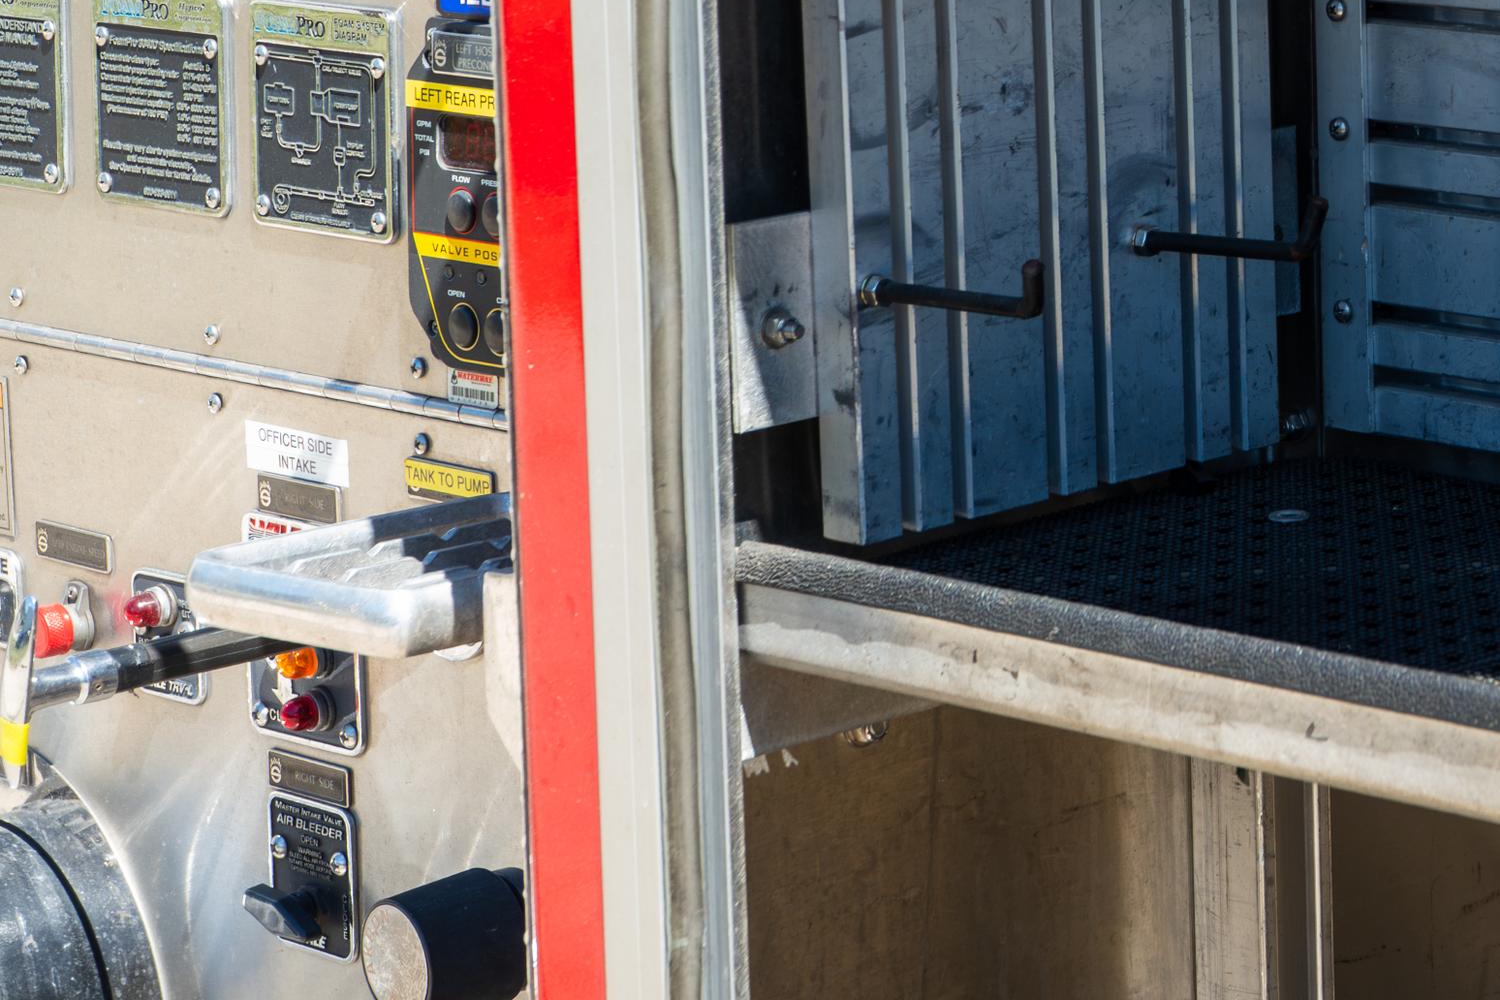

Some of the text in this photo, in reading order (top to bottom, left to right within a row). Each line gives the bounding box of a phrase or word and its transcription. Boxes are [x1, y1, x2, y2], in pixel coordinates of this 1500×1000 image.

[334, 18, 353, 28] FOAM
[334, 30, 367, 42] DIAGRAM
[456, 43, 472, 55] LEFT
[414, 87, 442, 102] LEFT
[445, 91, 476, 107] REAR
[416, 120, 432, 128] GPM
[414, 134, 434, 142] TOTAL
[452, 175, 471, 184] FLOW
[432, 243, 469, 257] VALVE
[447, 289, 466, 298] OPEN
[258, 428, 333, 456] OFFICER SIDE
[278, 454, 318, 475] INTAKE
[406, 465, 489, 494] TANK TO PUMP
[295, 772, 335, 791] RIGHT SIDE
[277, 813, 343, 840] AIR BLEEDER
[300, 834, 319, 847] OPEN
